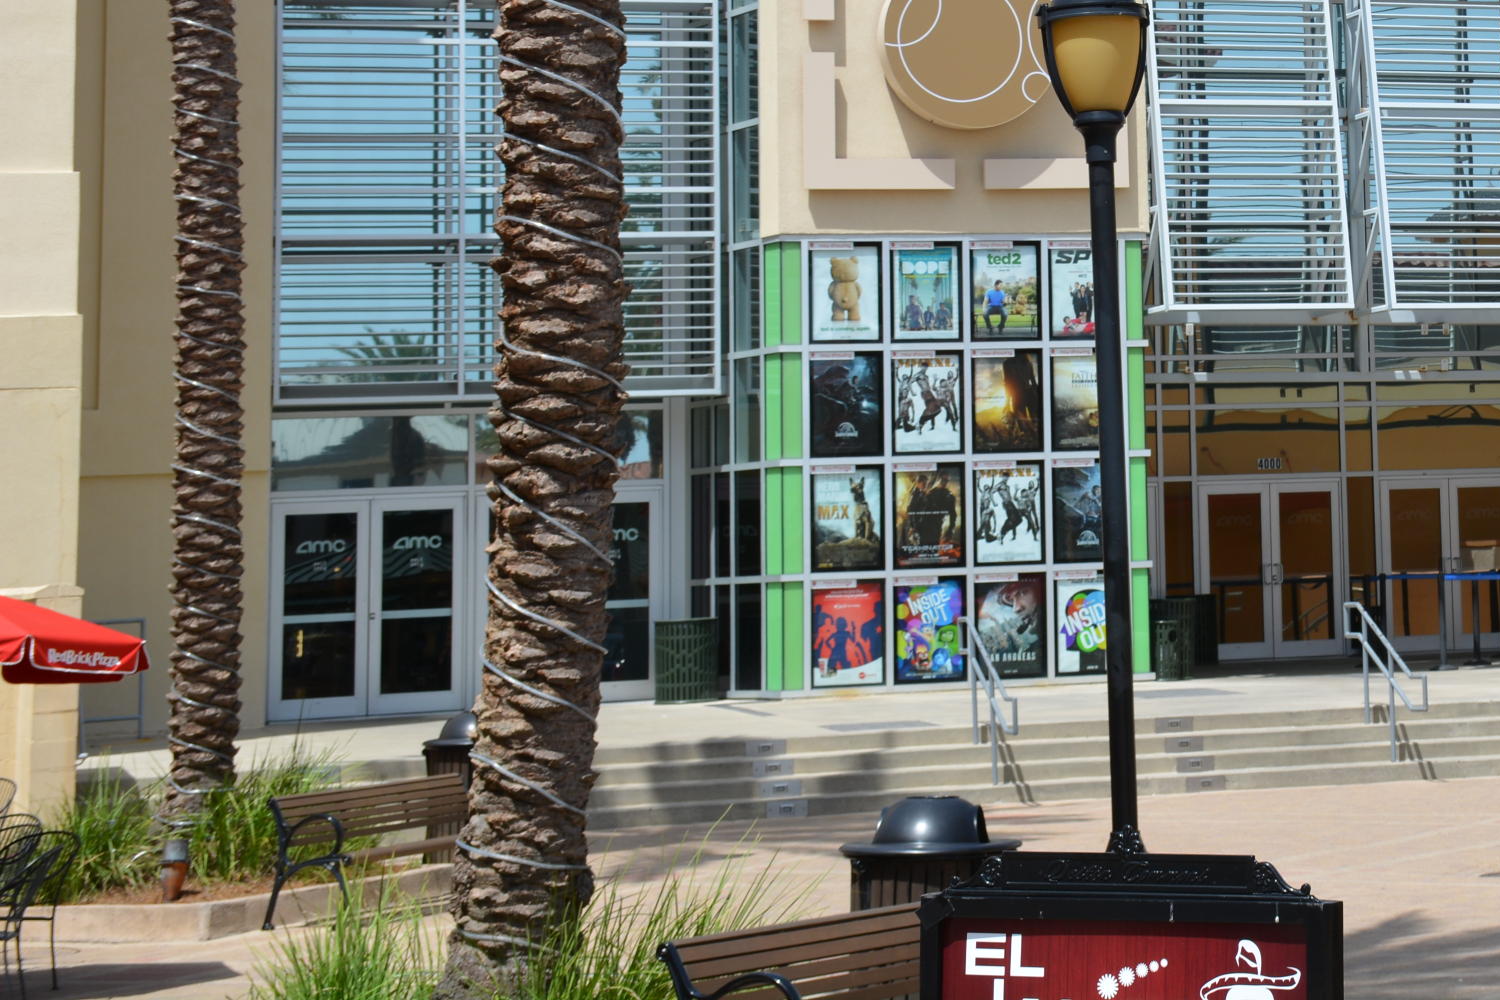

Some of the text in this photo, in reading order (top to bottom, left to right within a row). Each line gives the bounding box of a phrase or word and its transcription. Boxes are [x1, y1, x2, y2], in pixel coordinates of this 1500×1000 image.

[1055, 250, 1092, 264] SP
[901, 260, 950, 275] DOPE
[1257, 458, 1281, 470] 4000
[817, 503, 849, 520] MAX
[393, 535, 442, 549] amc
[612, 528, 639, 541] mc
[296, 539, 346, 554] amc
[901, 544, 954, 553] TERMINATOR
[907, 588, 951, 616] INSIDE
[921, 604, 948, 625] OUT
[1063, 601, 1106, 636] INSID
[1081, 626, 1106, 650] OU
[1002, 651, 1037, 663] ANDREAS
[965, 932, 1045, 977] EL
